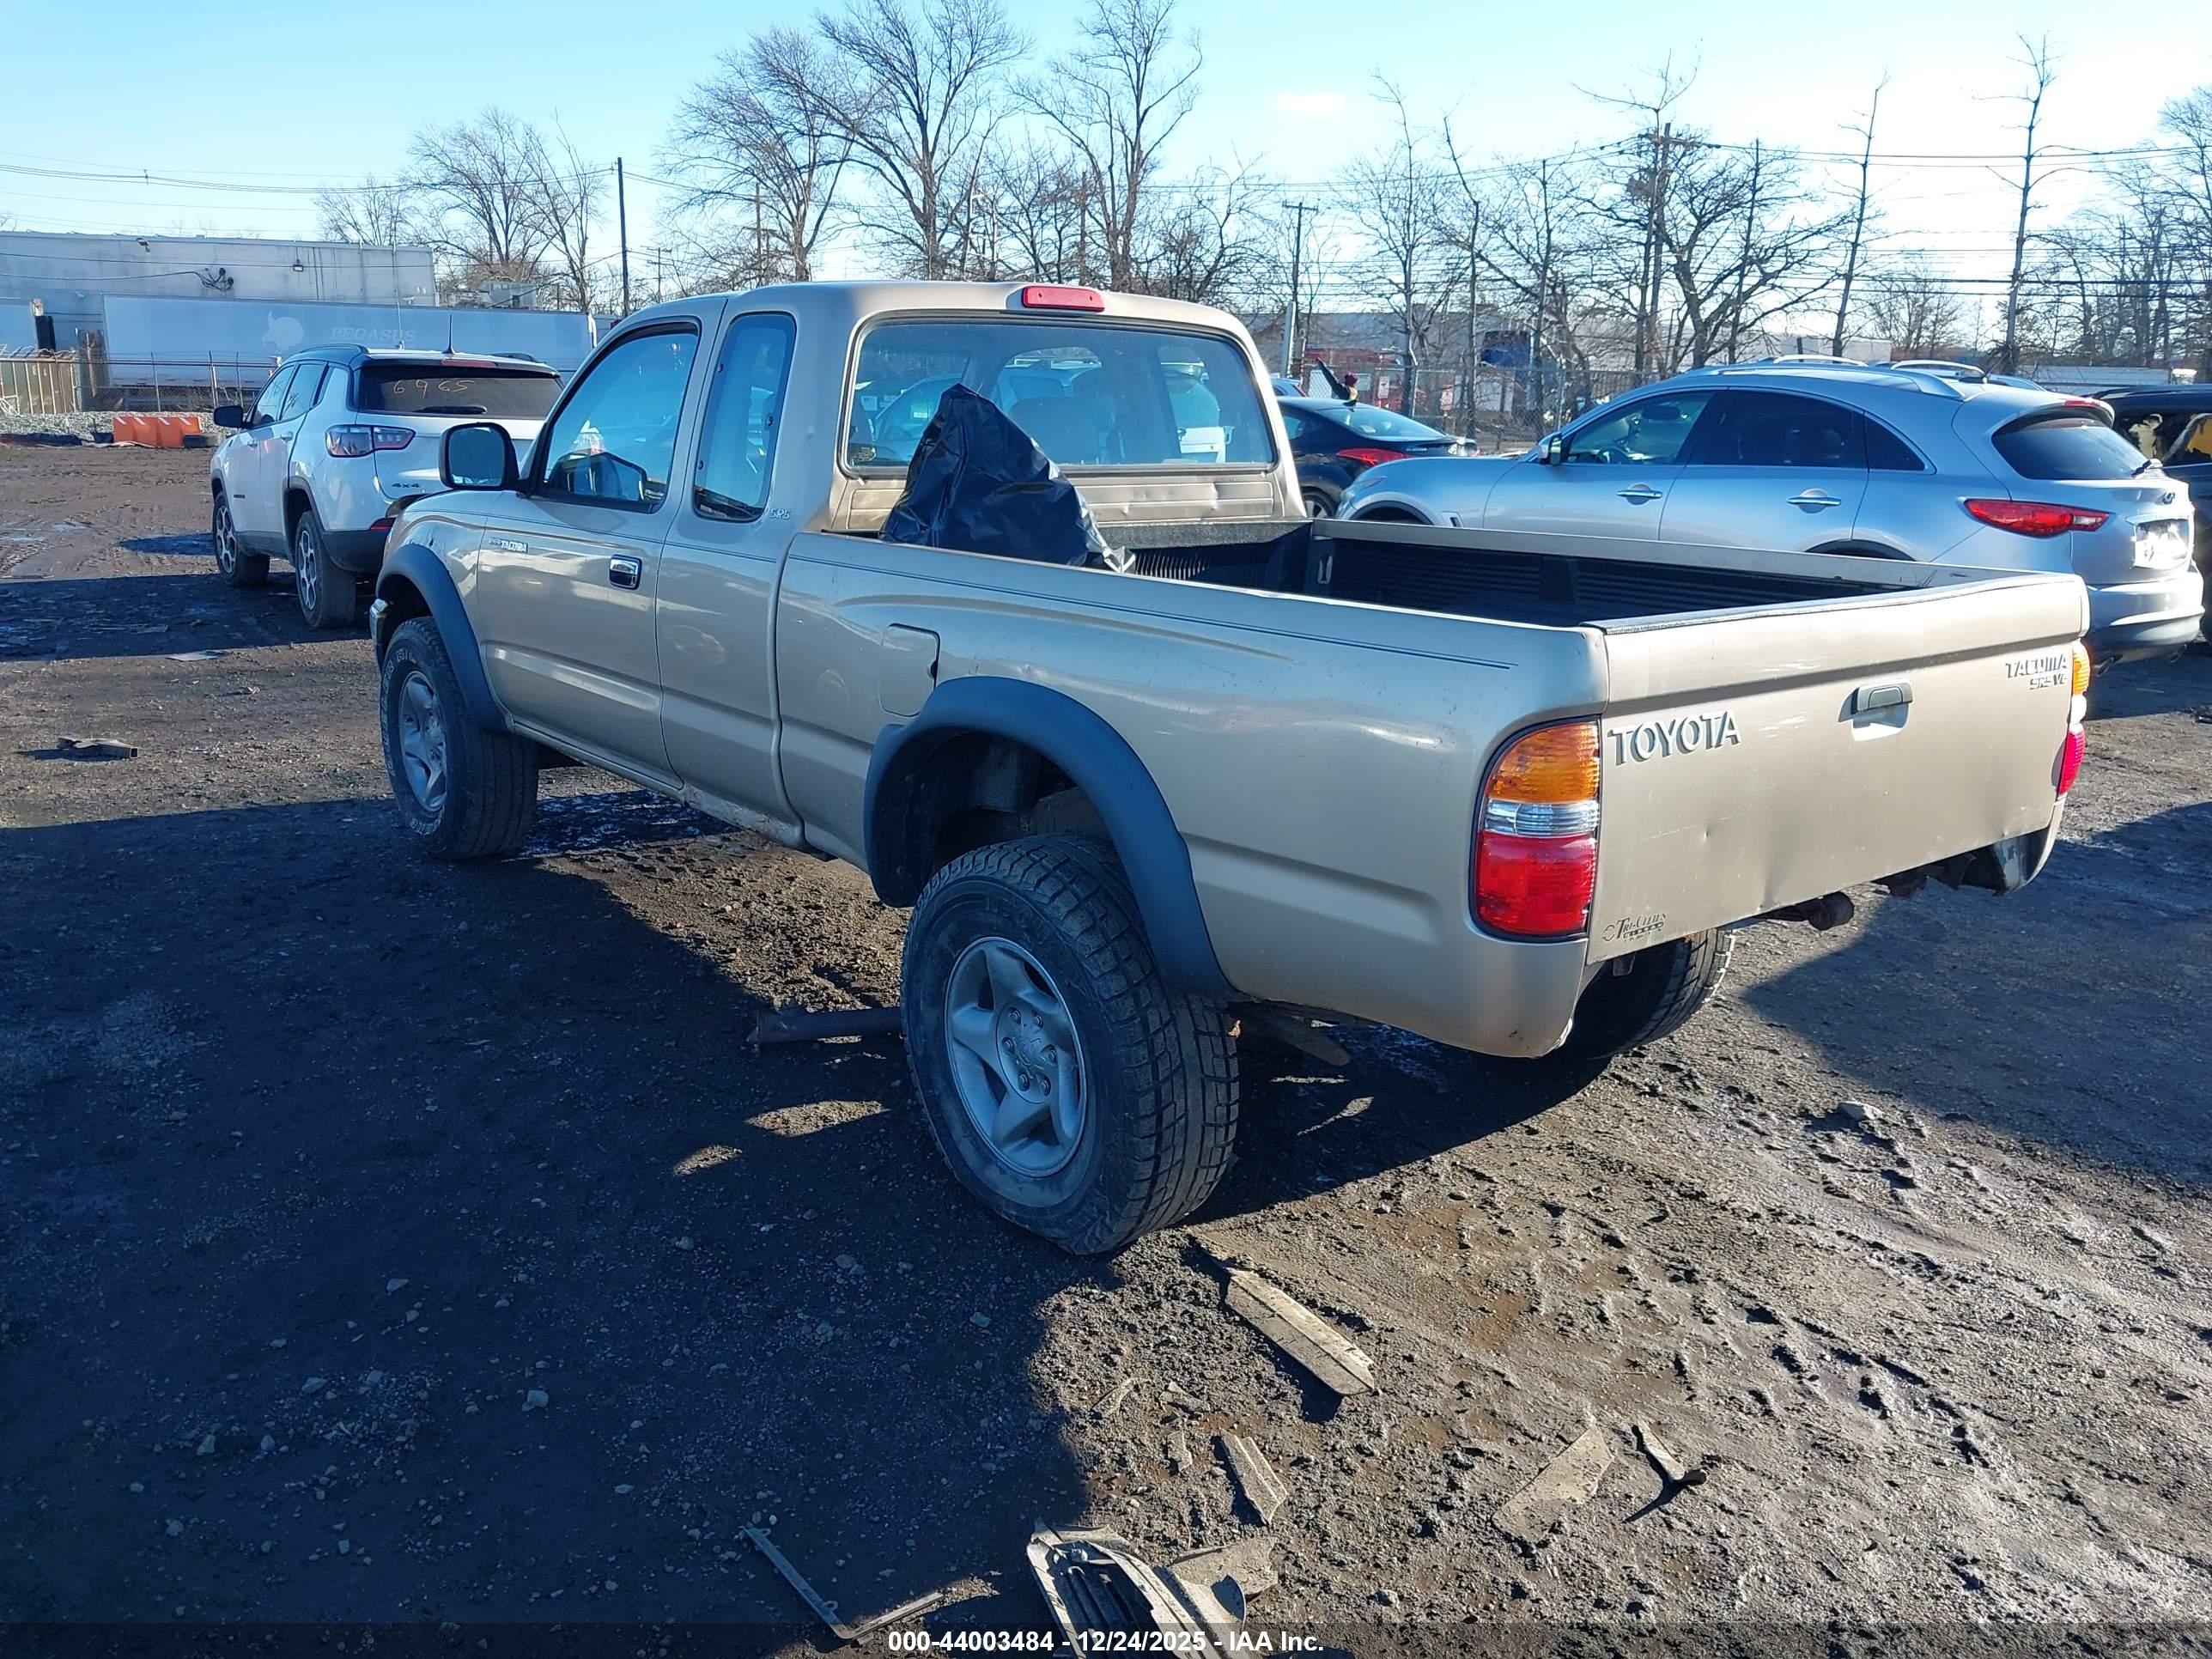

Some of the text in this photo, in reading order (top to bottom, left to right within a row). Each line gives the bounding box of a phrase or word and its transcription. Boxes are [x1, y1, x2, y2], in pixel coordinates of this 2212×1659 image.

[330, 327, 416, 342] PEGASUS
[393, 379, 475, 399] 6965
[769, 508, 792, 520] SR5
[2005, 653, 2069, 678] TACOMA
[1606, 710, 1741, 767] TOYOTA
